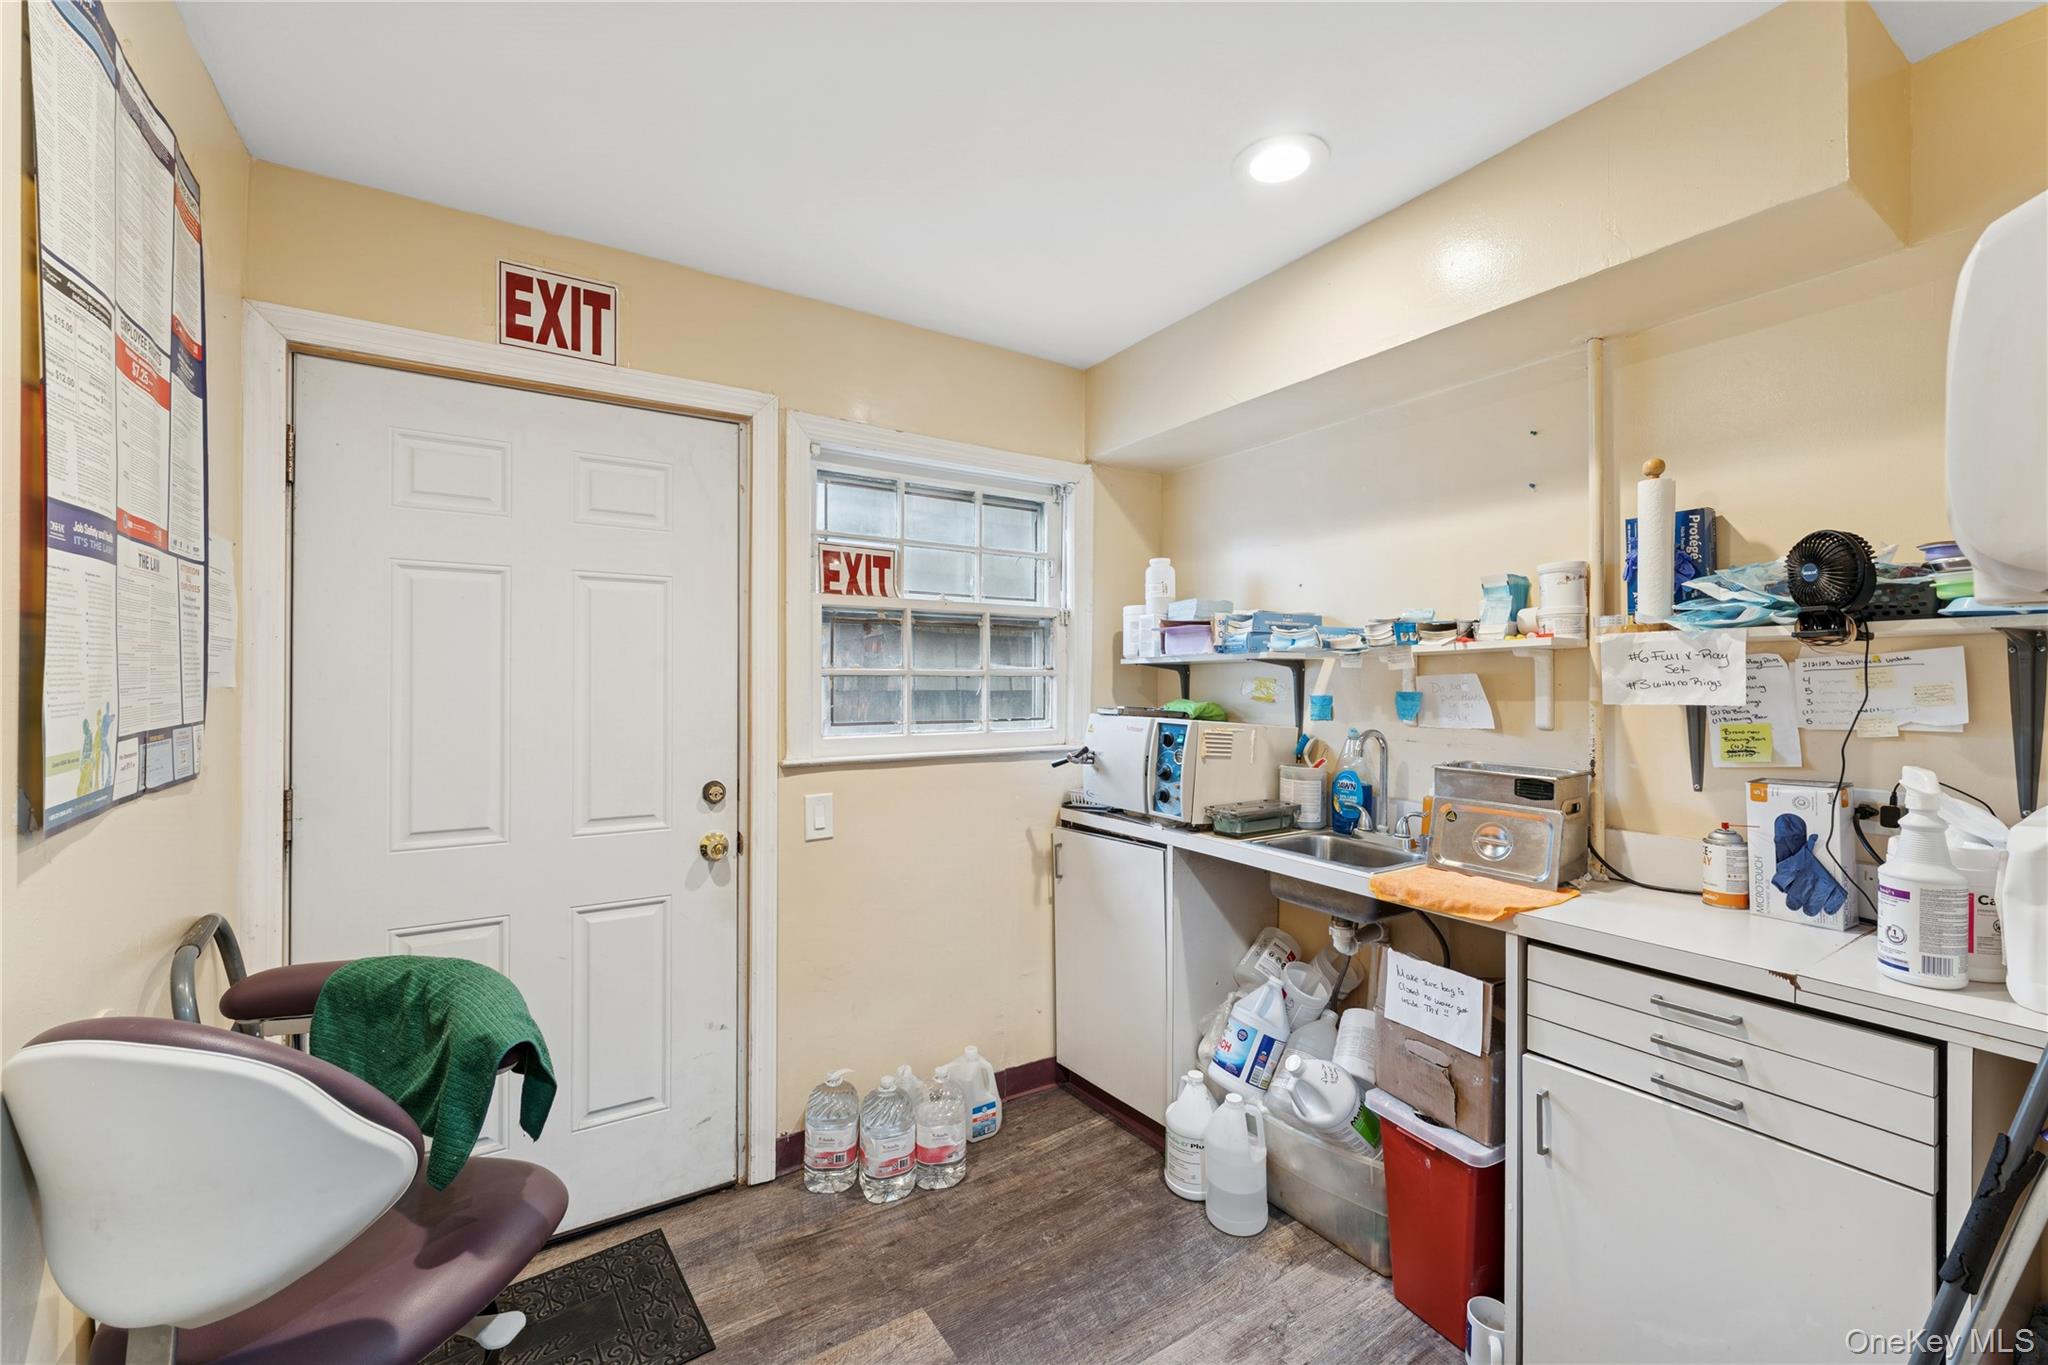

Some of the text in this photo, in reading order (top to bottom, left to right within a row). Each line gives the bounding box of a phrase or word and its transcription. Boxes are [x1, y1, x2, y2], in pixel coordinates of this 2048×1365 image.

[505, 270, 611, 356] EXIT
[121, 315, 149, 351] EMPLOYEE
[73, 535, 89, 548] IT'S
[90, 539, 102, 551] THE
[1686, 514, 1702, 560] Protégé
[138, 553, 149, 570] THE
[822, 550, 891, 598] EXIT
[1628, 650, 1649, 663] #6
[1664, 664, 1691, 674] Set
[1802, 676, 1811, 685] 4
[1804, 687, 1814, 695] 5
[1396, 963, 1419, 983] Make
[1440, 981, 1456, 998] bag
